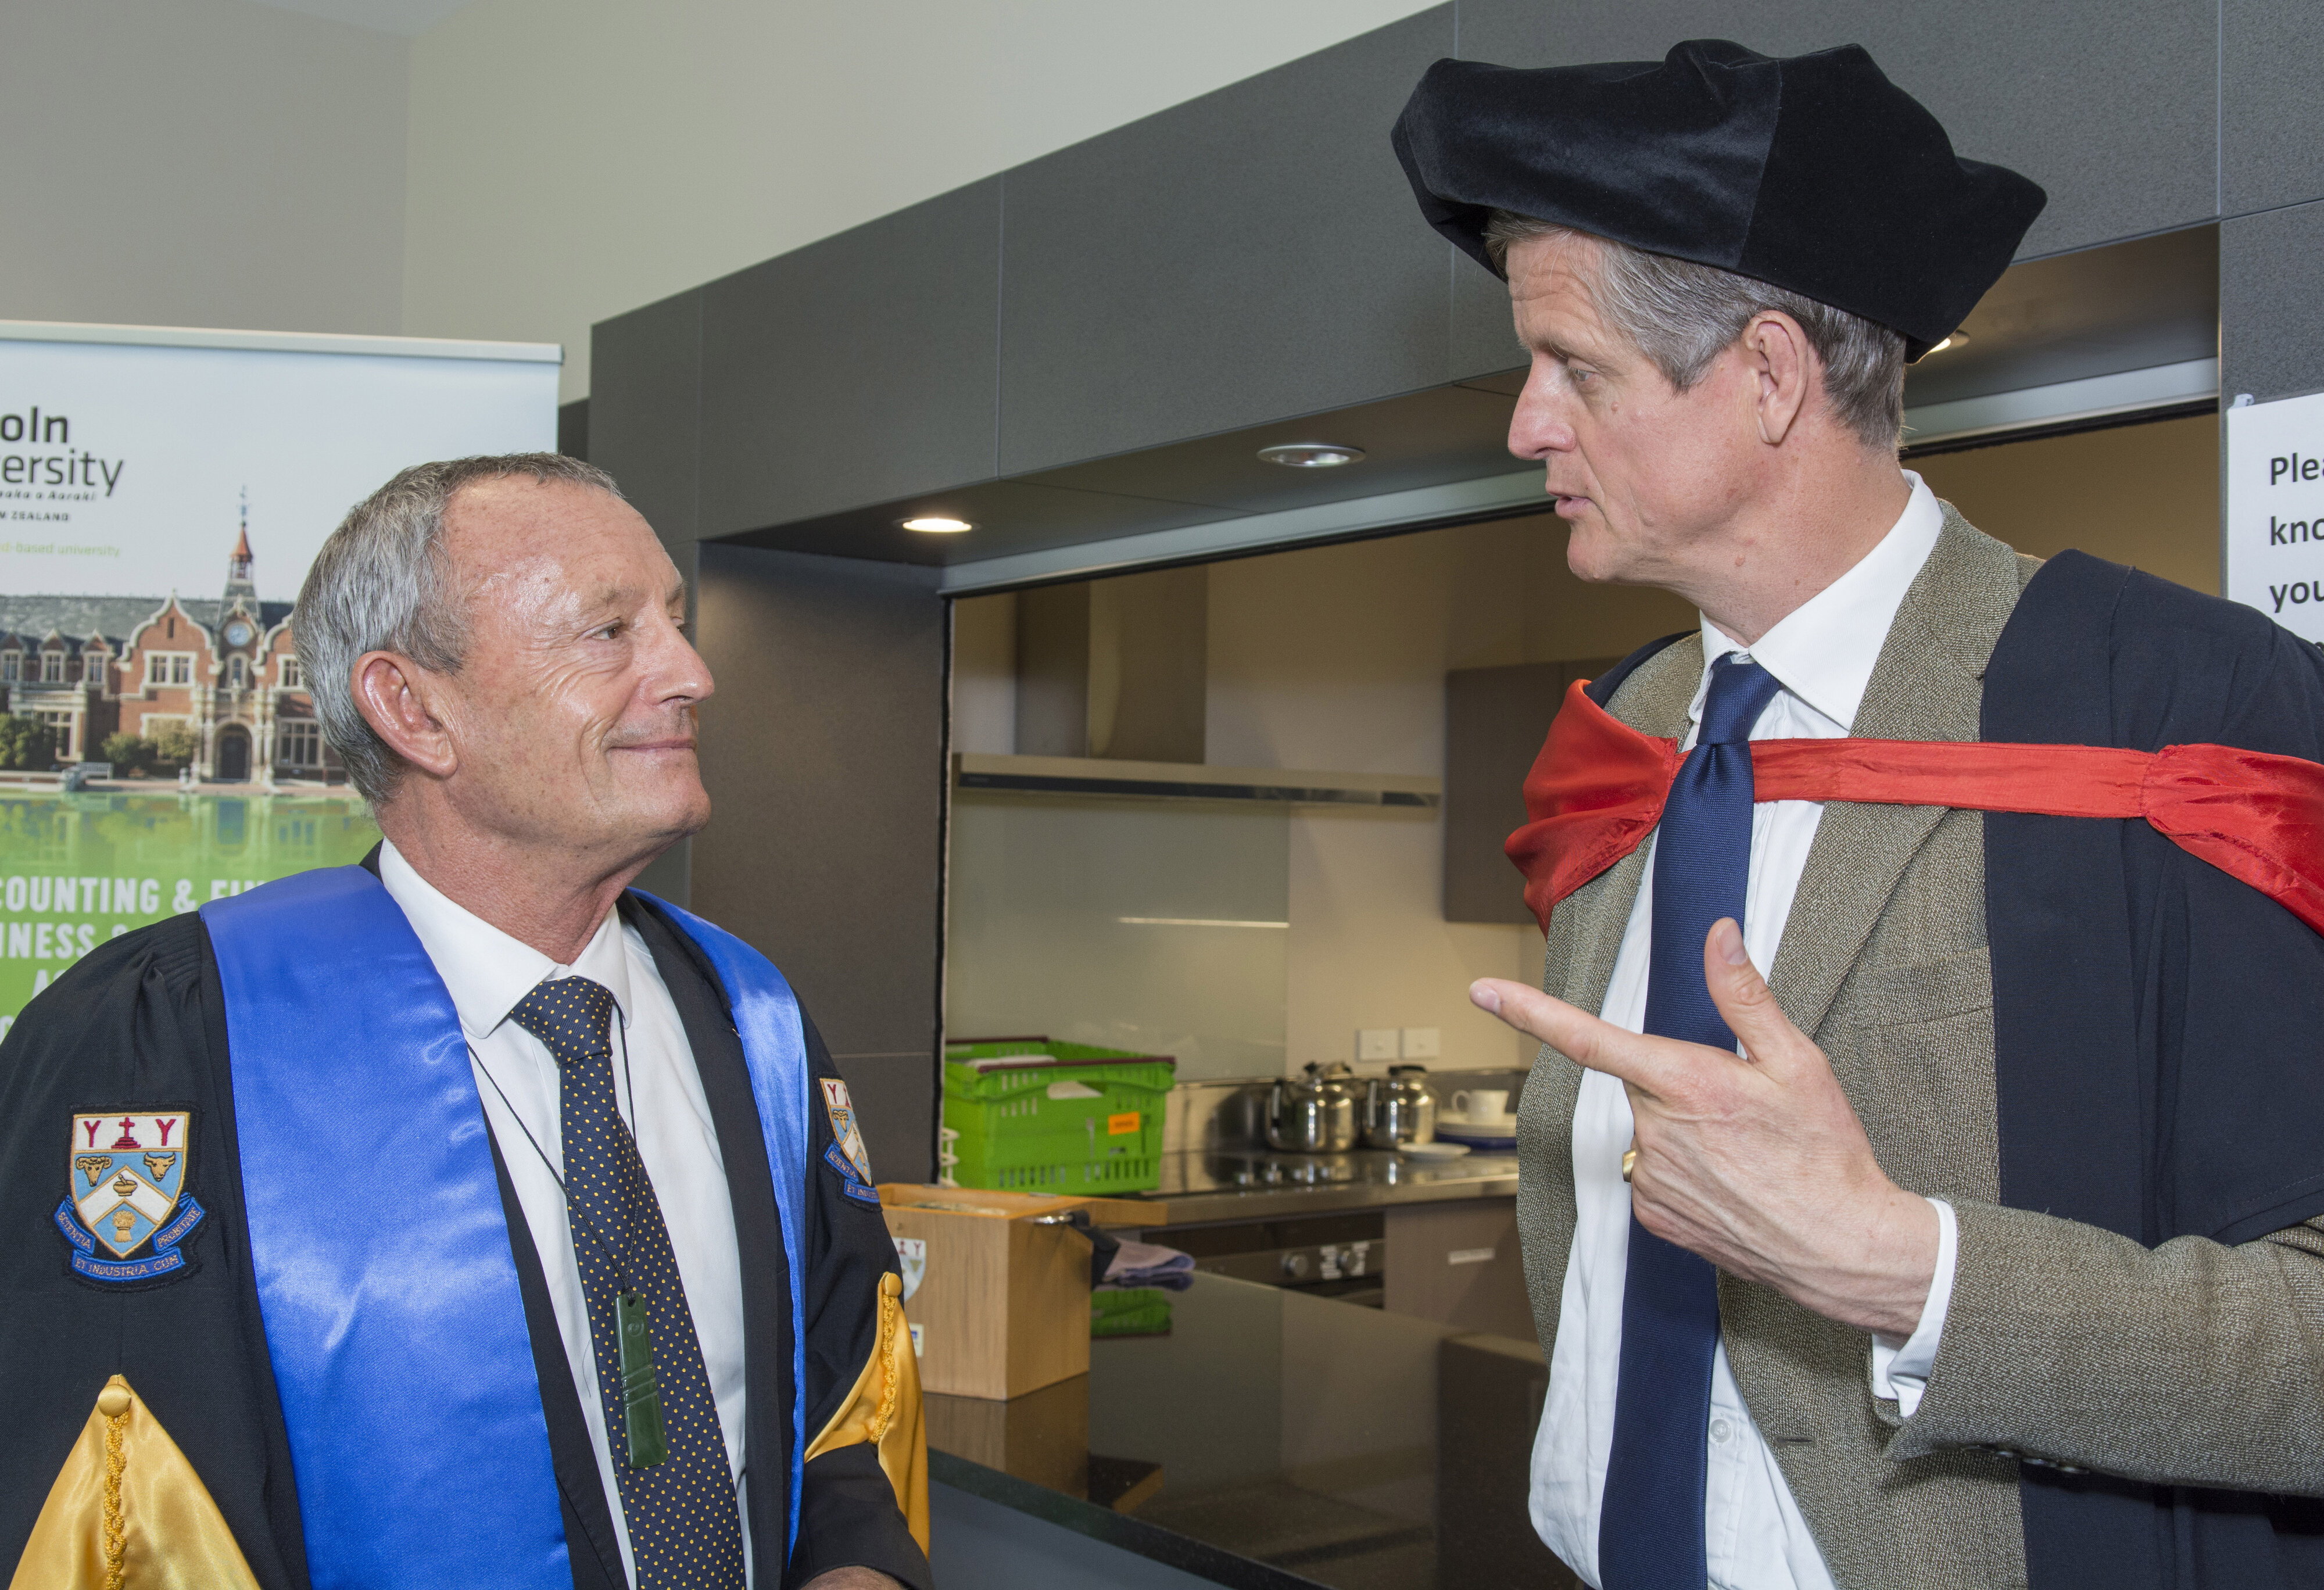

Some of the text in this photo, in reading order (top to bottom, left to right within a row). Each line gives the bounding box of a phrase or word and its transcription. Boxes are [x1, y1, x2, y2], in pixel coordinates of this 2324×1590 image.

[0, 406, 69, 443] oln
[2, 448, 124, 497] ersity
[2271, 452, 2324, 485] Ple
[10, 511, 69, 521] ZEALAND
[58, 545, 119, 557] university
[173, 879, 196, 914] &
[828, 1151, 856, 1178] SCIENTIA
[847, 1184, 855, 1193] ET
[58, 1212, 91, 1249] SCIENTIA
[75, 1255, 179, 1276] ET INDUSTRIA CUM
